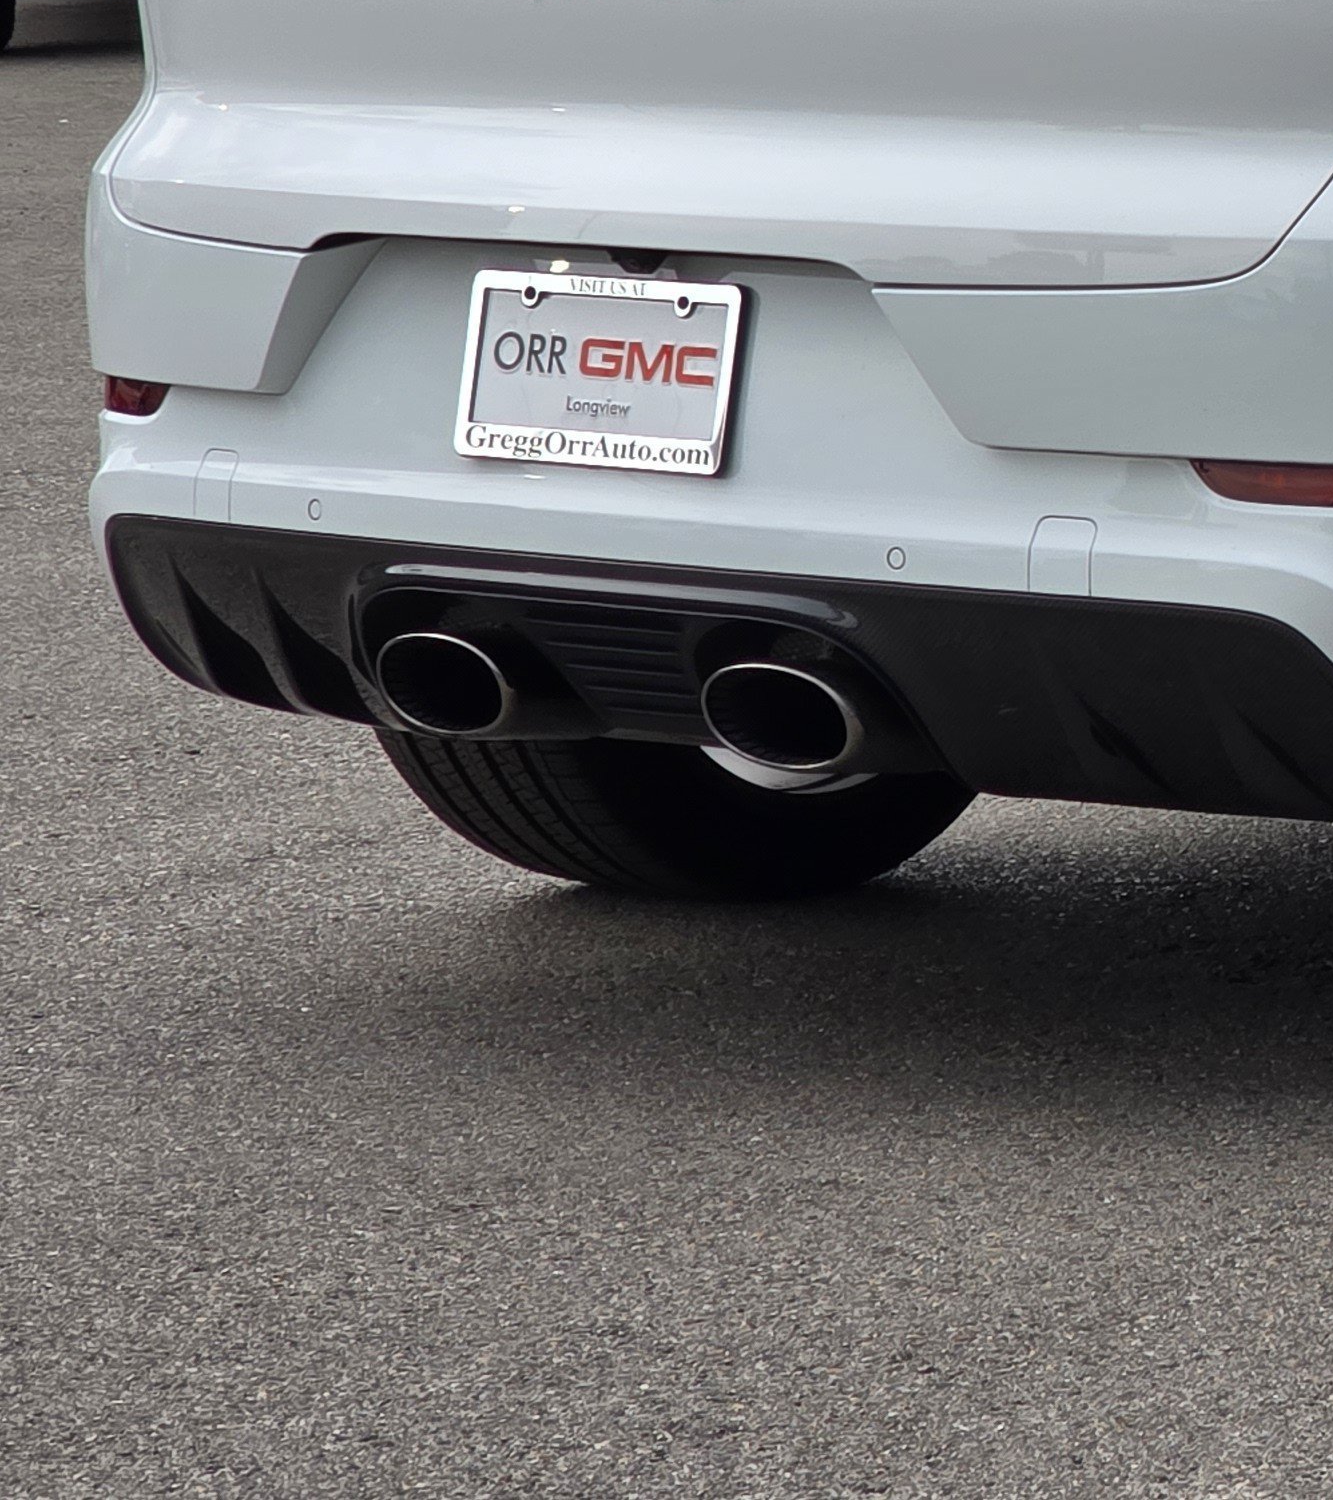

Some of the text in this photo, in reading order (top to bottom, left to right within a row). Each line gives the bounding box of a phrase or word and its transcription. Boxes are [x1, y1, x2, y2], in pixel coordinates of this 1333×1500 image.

[570, 278, 606, 293] VISIT
[610, 281, 626, 294] US
[494, 331, 718, 388] ORR GMC
[566, 395, 632, 418] Longview
[465, 424, 711, 467] GreggOrrAuto.com
